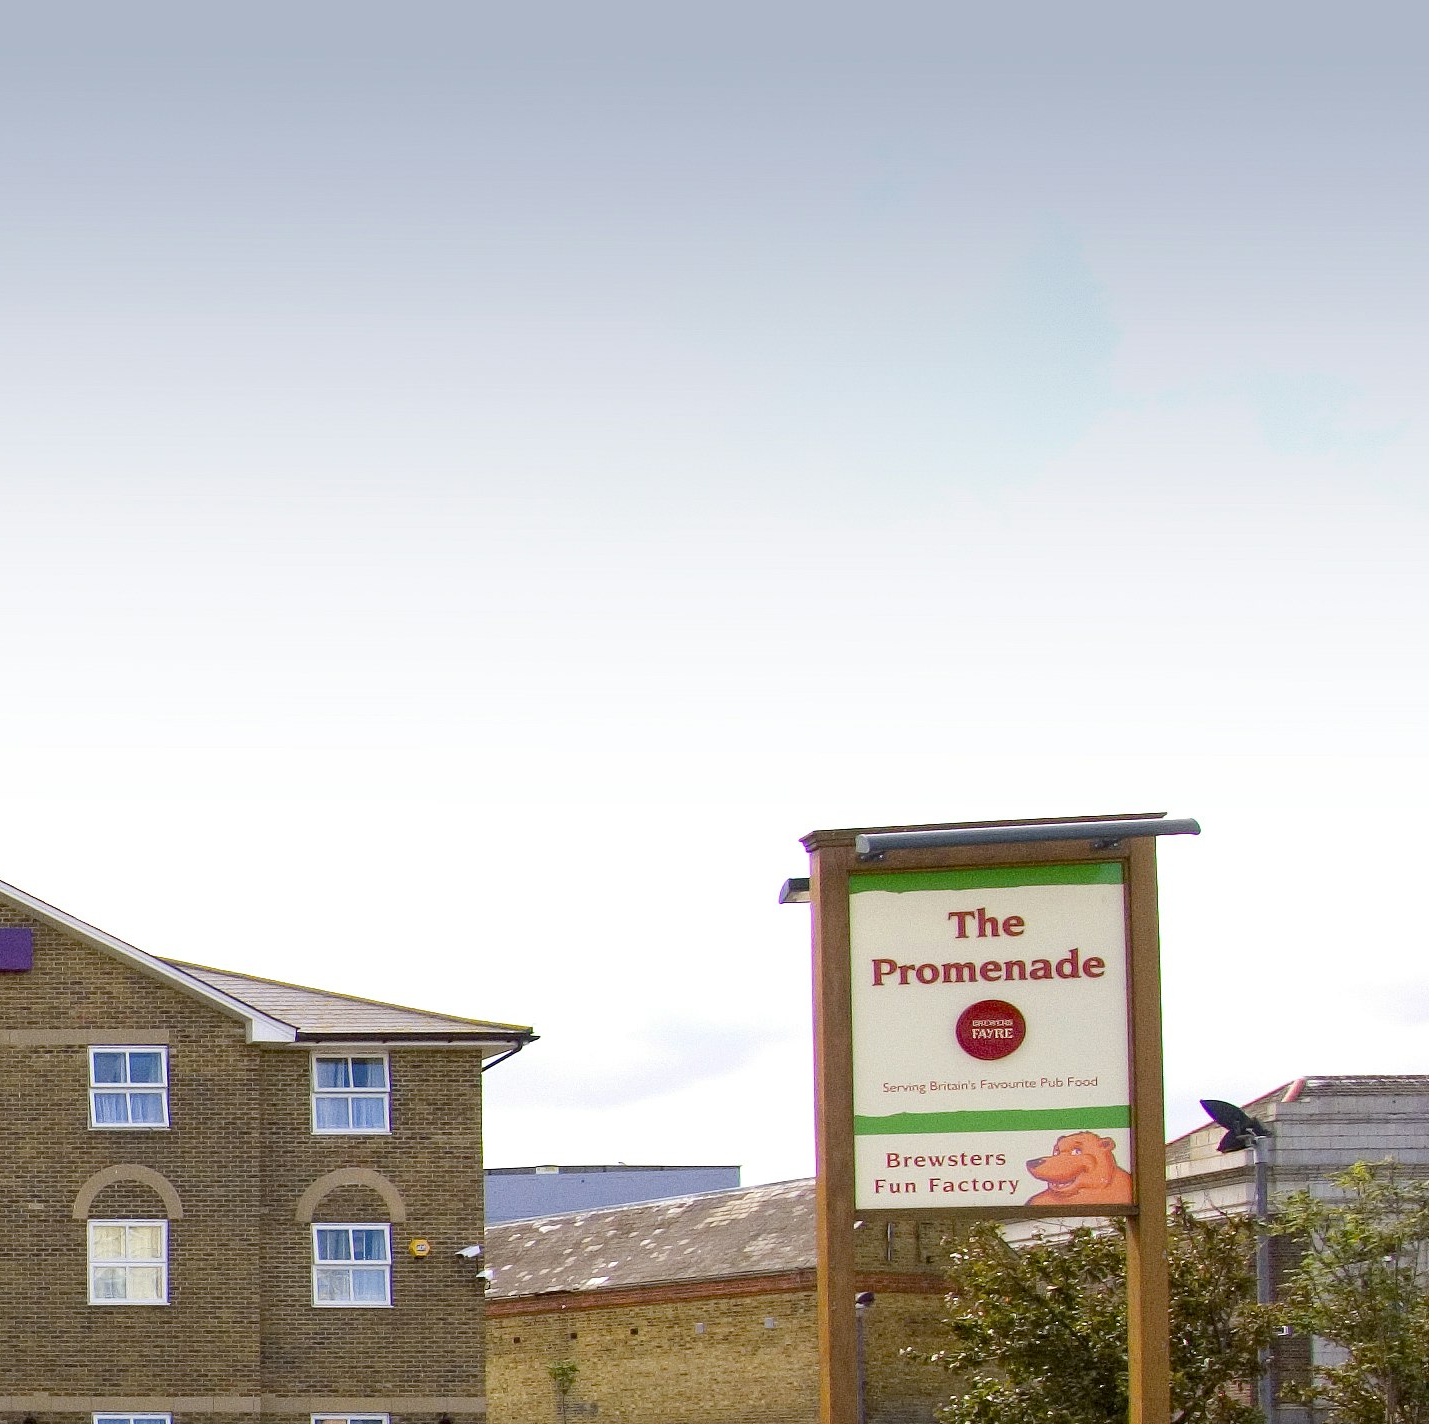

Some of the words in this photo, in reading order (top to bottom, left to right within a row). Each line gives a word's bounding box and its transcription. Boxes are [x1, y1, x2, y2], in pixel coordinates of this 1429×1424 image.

[948, 907, 1025, 939] The
[871, 948, 1107, 987] Promenade
[971, 1028, 1014, 1039] FAYRE
[882, 1082, 926, 1094] Serving
[930, 1080, 976, 1091] Britain's
[980, 1079, 1037, 1090] Favourite
[1040, 1077, 1063, 1088] Pub
[1067, 1076, 1099, 1087] Food
[885, 1151, 1007, 1169] Brewsters
[874, 1178, 917, 1194] Fun
[928, 1177, 1020, 1196] Factory
